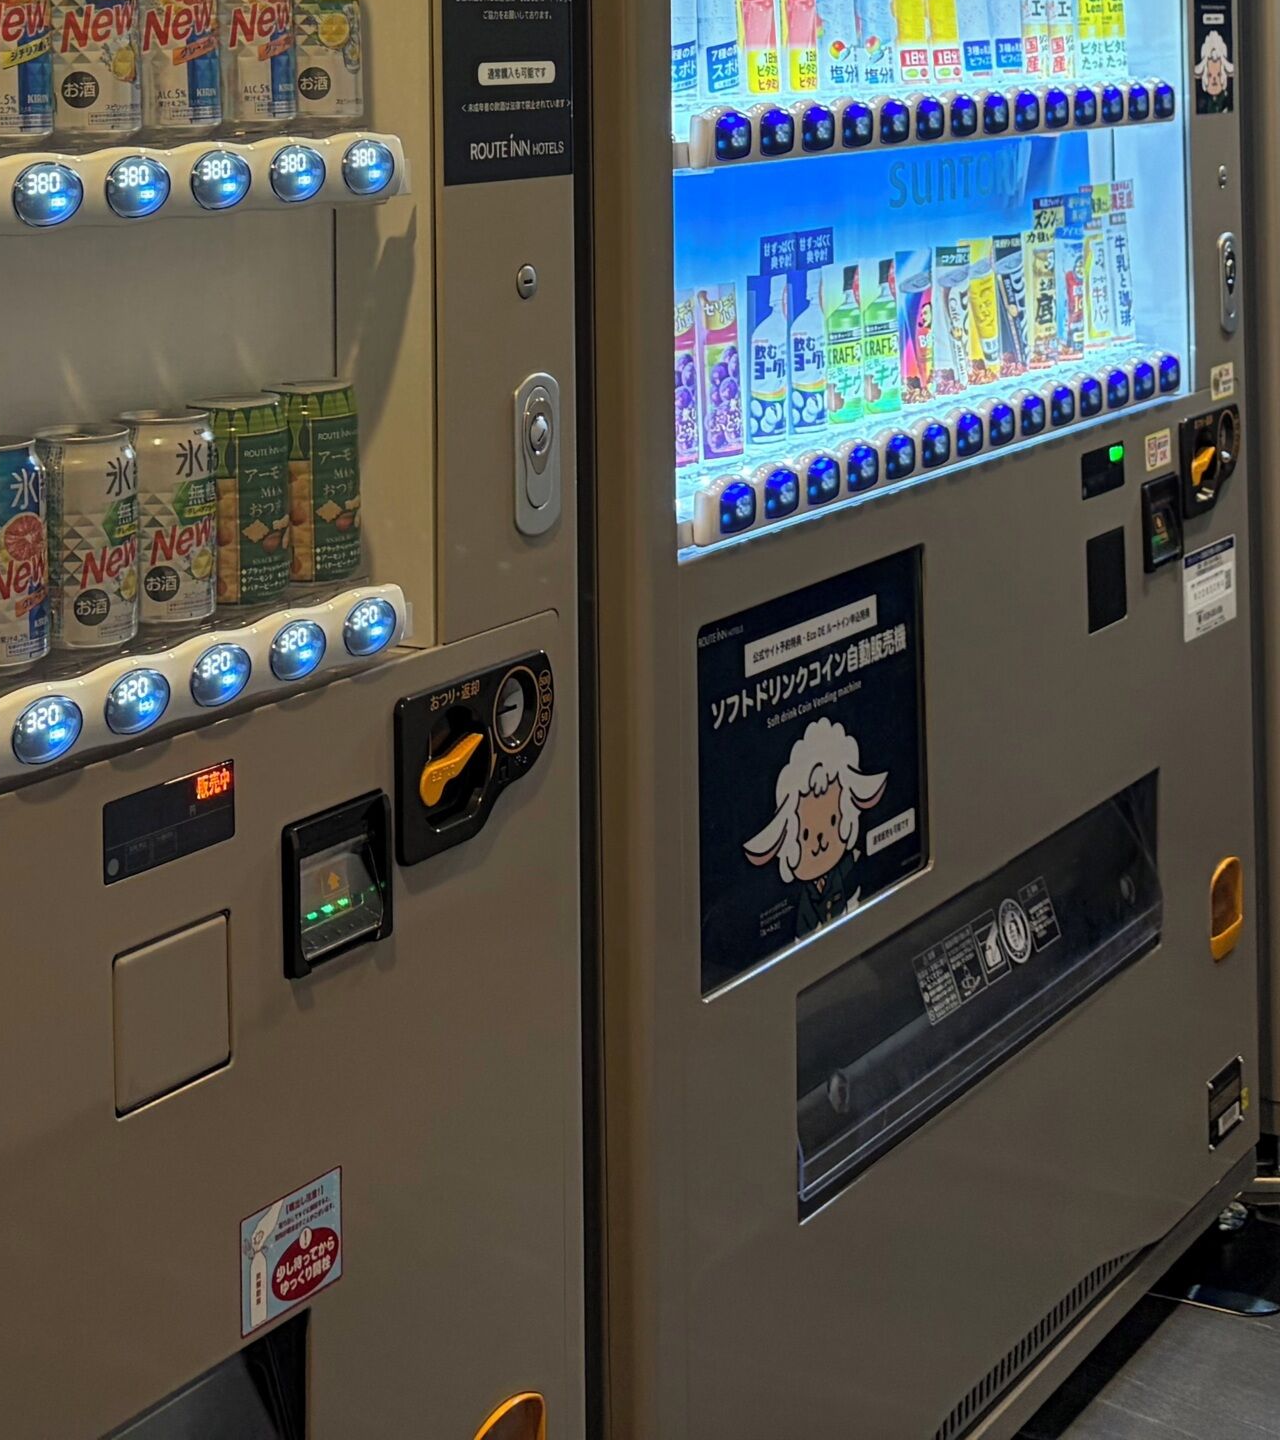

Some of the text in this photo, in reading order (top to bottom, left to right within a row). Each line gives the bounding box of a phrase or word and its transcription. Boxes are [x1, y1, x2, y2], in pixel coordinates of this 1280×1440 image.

[60, 0, 136, 56] New
[142, 2, 213, 54] New
[228, 3, 290, 51] New
[64, 81, 98, 101] お酒
[300, 74, 328, 94] お酒
[351, 147, 376, 169] 380
[471, 141, 508, 160] ROUTE
[533, 140, 565, 155] HOTELS
[118, 164, 150, 188] 380
[202, 160, 231, 182] 380
[280, 153, 307, 176] 380
[27, 171, 61, 195] 380
[151, 518, 213, 566] New
[81, 537, 137, 591] New
[145, 576, 178, 594] お酒
[76, 598, 108, 617] お酒
[353, 604, 378, 632] 320
[280, 627, 308, 655] 320
[201, 651, 231, 679] 320
[711, 622, 908, 730] ソフトドリンクコイン自動販売機
[117, 676, 149, 705] 320
[26, 703, 61, 734] 320
[196, 765, 232, 801] 販売中
